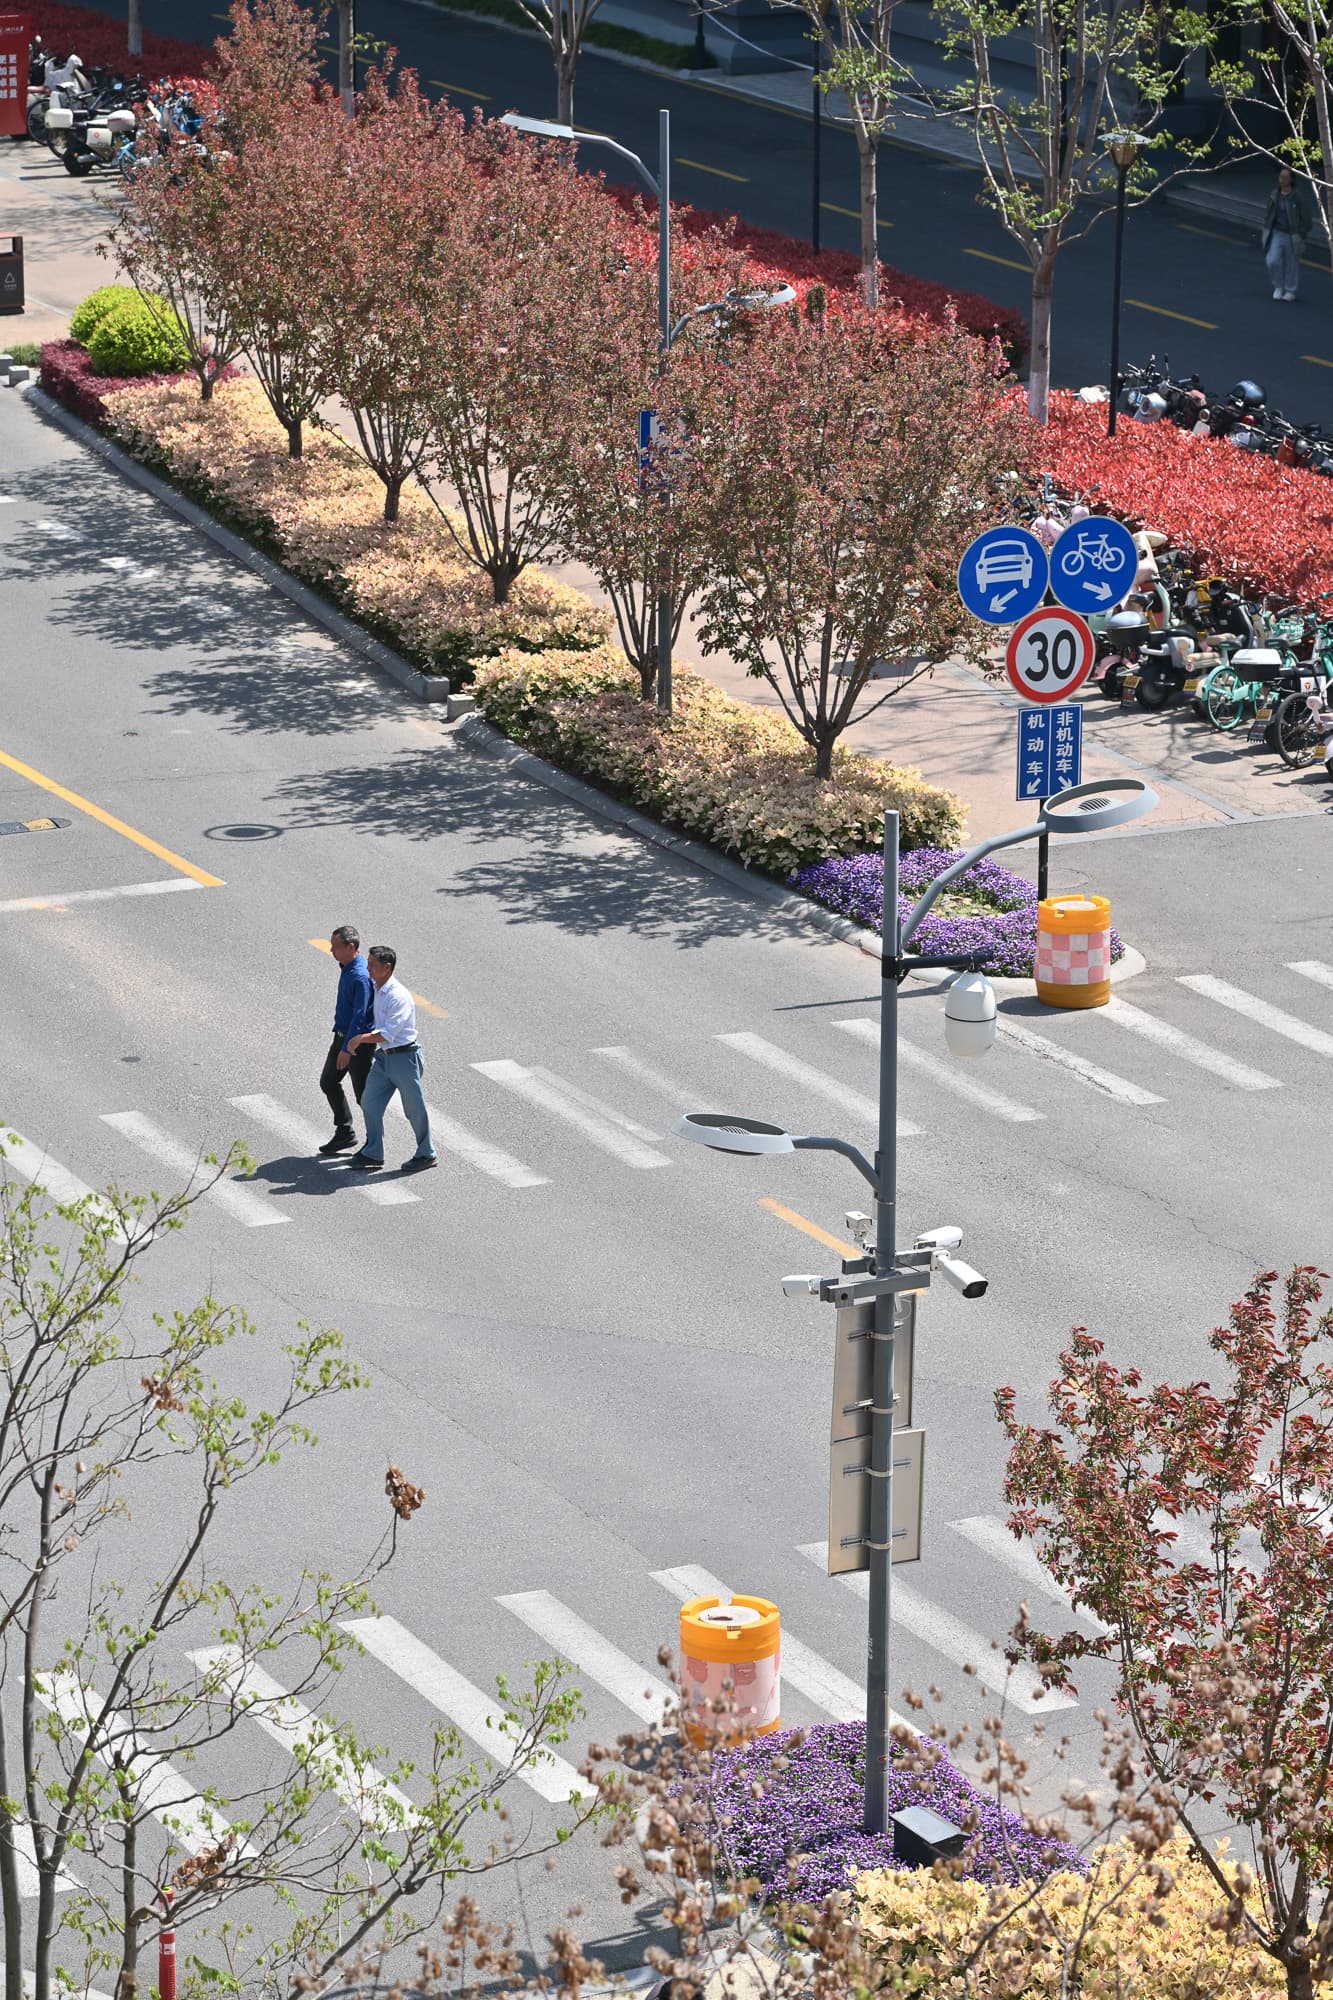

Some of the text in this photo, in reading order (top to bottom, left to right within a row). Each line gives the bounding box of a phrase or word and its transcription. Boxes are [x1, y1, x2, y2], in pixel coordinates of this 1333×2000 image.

[1025, 630, 1076, 682] 30
[1026, 713, 1045, 776] 机动车
[1055, 711, 1074, 773] 非机动车
